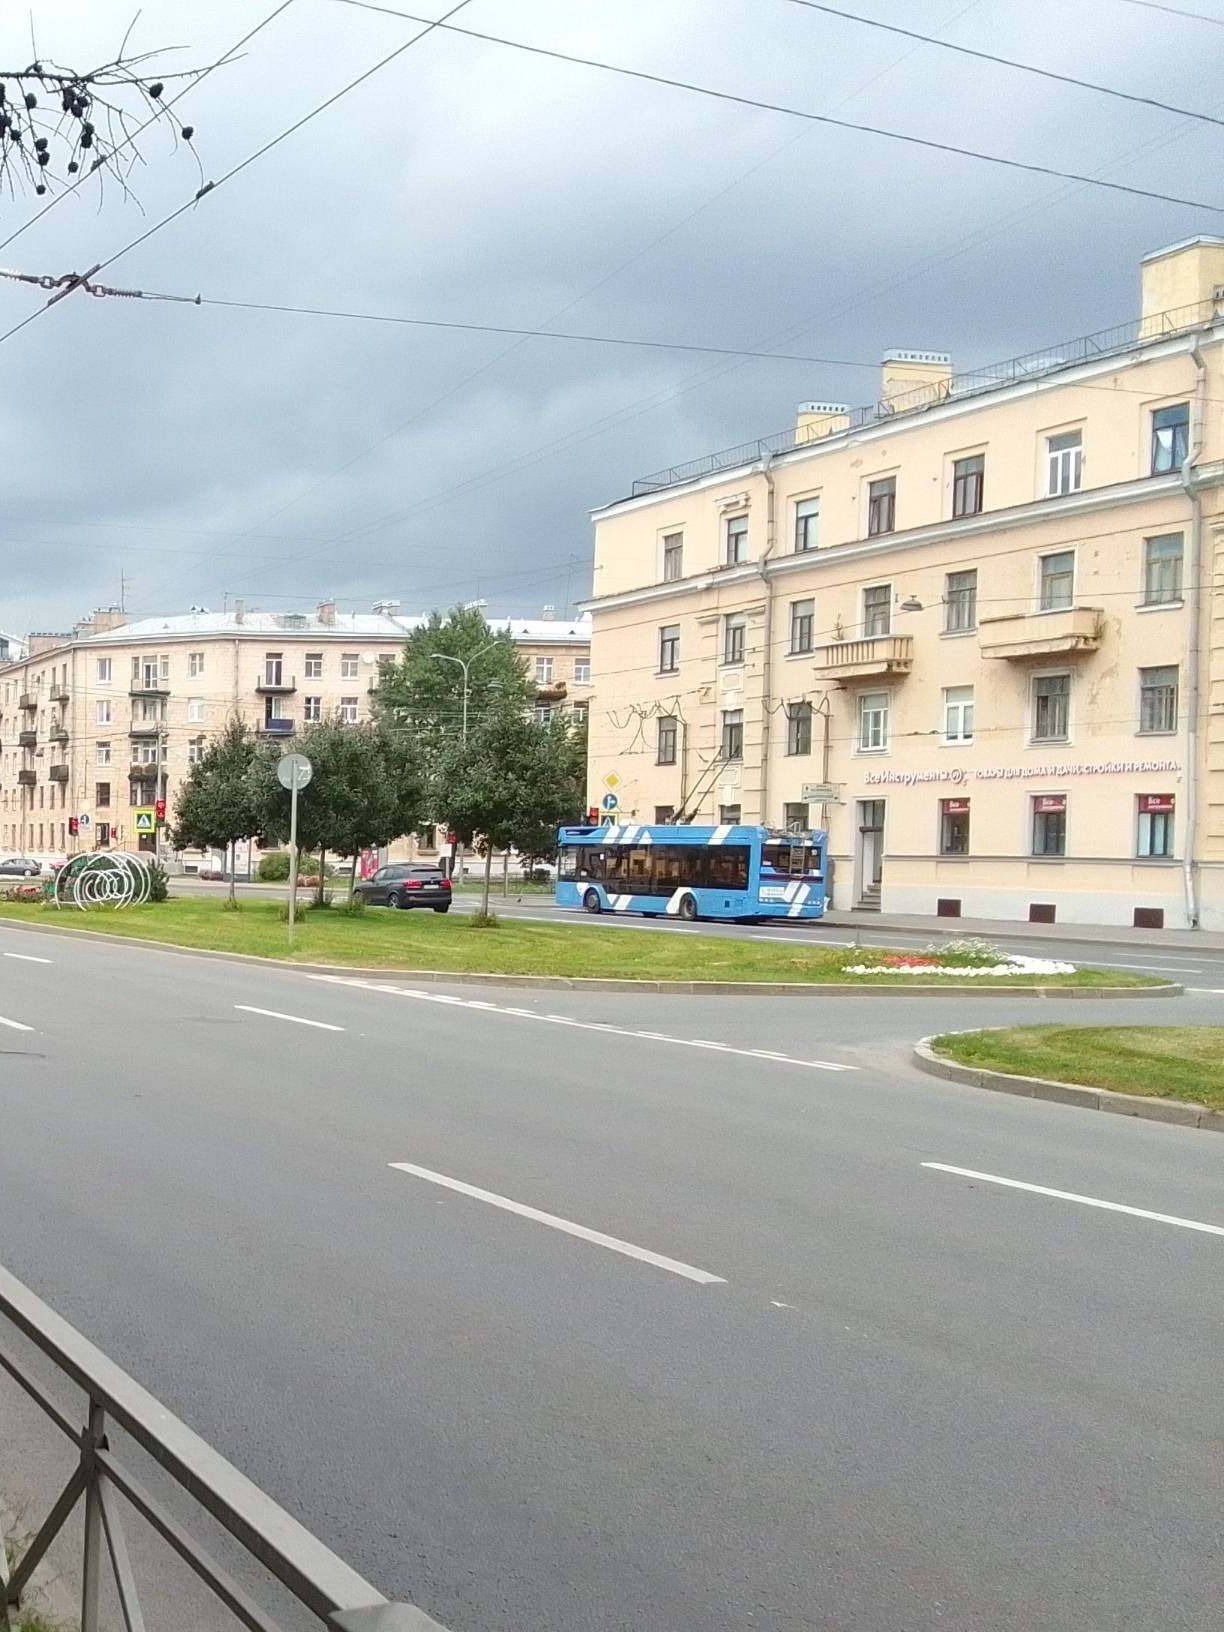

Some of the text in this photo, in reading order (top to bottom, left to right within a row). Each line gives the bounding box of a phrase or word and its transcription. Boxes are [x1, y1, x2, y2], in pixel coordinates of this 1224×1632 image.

[1022, 766, 1047, 778] ДОМА
[1048, 766, 1056, 776] И
[1084, 762, 1124, 775] СТРОЙКИ
[1125, 762, 1133, 773] И
[1133, 760, 1177, 773] РЕМОНТА
